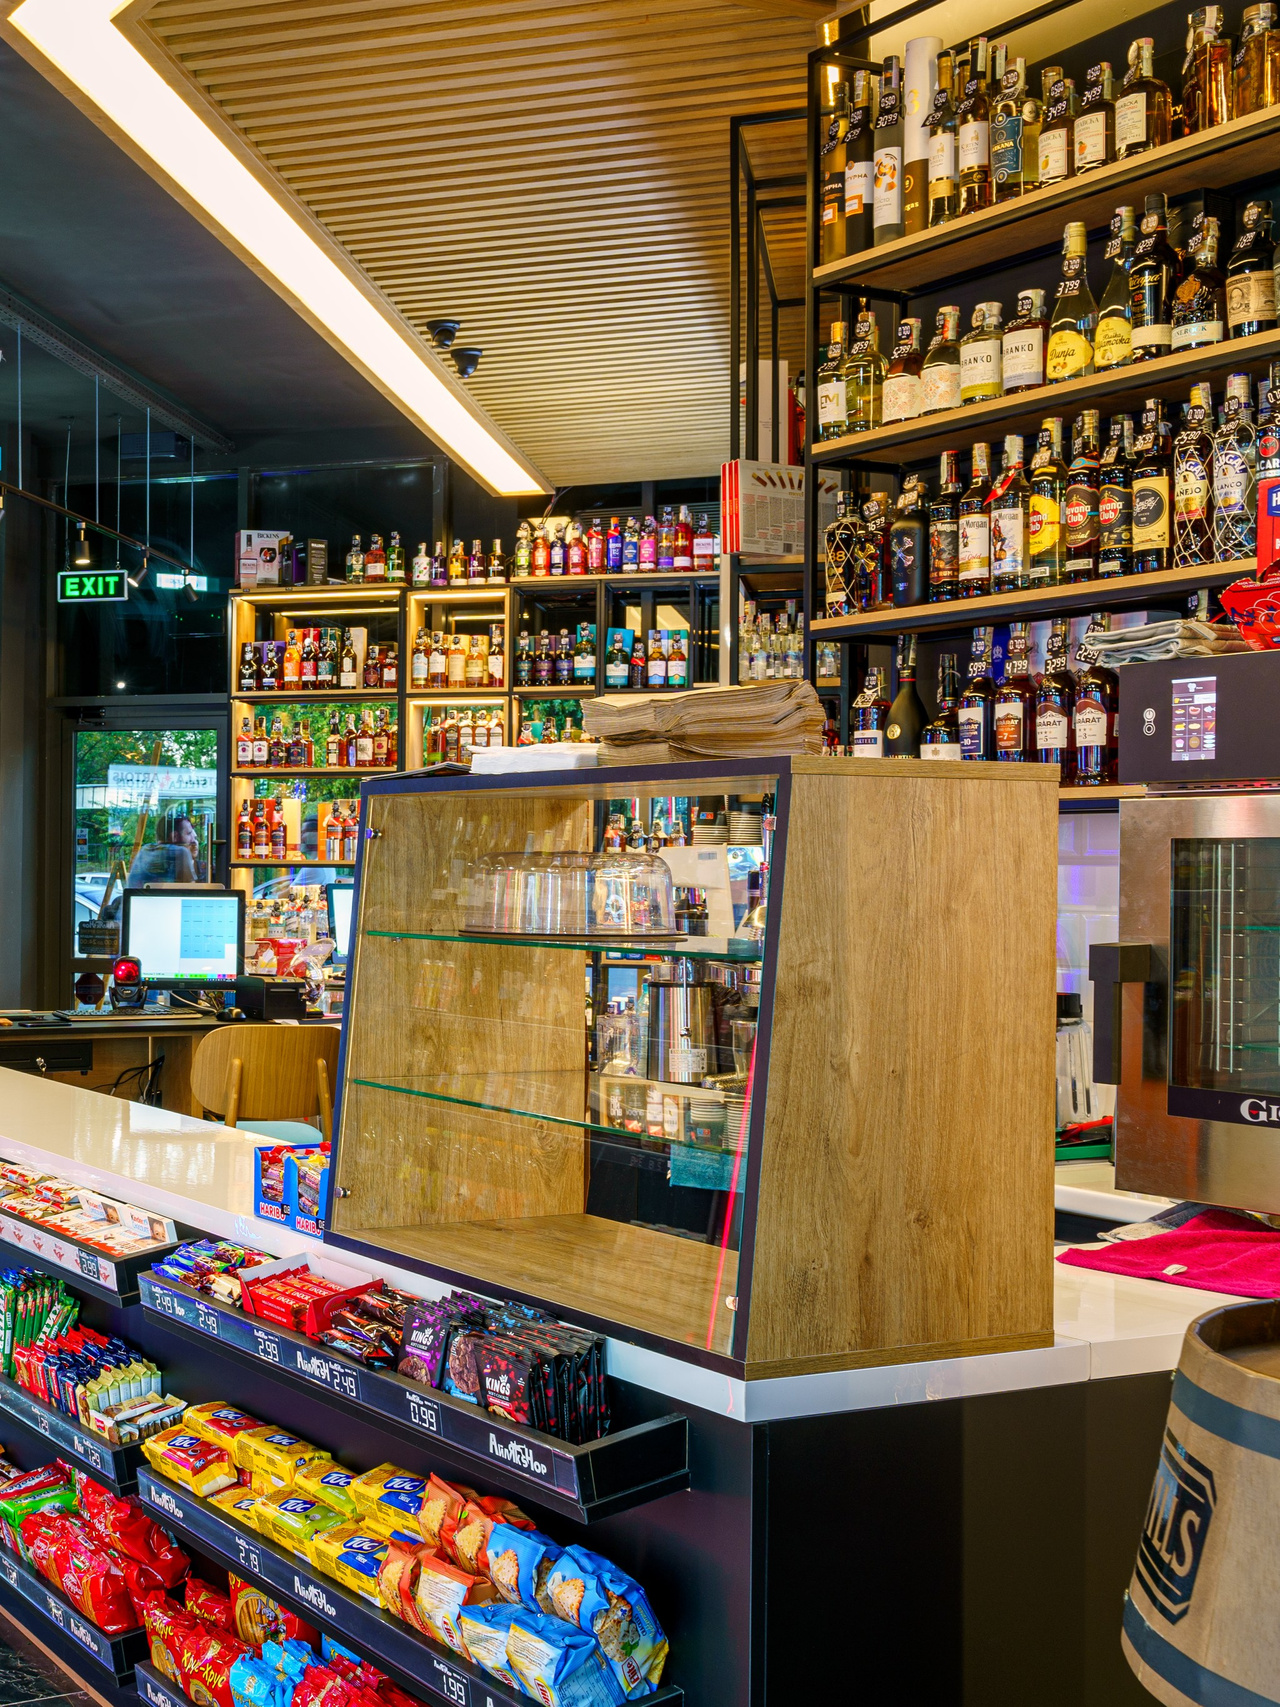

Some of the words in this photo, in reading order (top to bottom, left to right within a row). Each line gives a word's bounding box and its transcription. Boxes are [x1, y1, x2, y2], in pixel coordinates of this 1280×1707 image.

[966, 519, 988, 529] Morgan
[65, 576, 119, 597] EXIT
[1005, 660, 1028, 673] 4799
[82, 1257, 98, 1278] 2.99
[155, 1293, 173, 1314] 2.49
[199, 1310, 218, 1335] 2.49
[410, 1330, 434, 1346] KINGS
[258, 1338, 279, 1361] 2.99
[333, 1371, 356, 1397] 2.49
[485, 1376, 511, 1396] KINGS
[224, 1409, 242, 1420] TUC
[410, 1402, 437, 1431] 0.99
[172, 1435, 196, 1448] TUC
[274, 1434, 299, 1446] TUC
[327, 1472, 352, 1487] TUC
[387, 1477, 421, 1490] TUC
[284, 1499, 313, 1512] TUC
[349, 1538, 379, 1550] TUC
[239, 1548, 258, 1573] 2.19
[623, 1659, 641, 1687] Elite
[442, 1673, 466, 1706] 1.99
